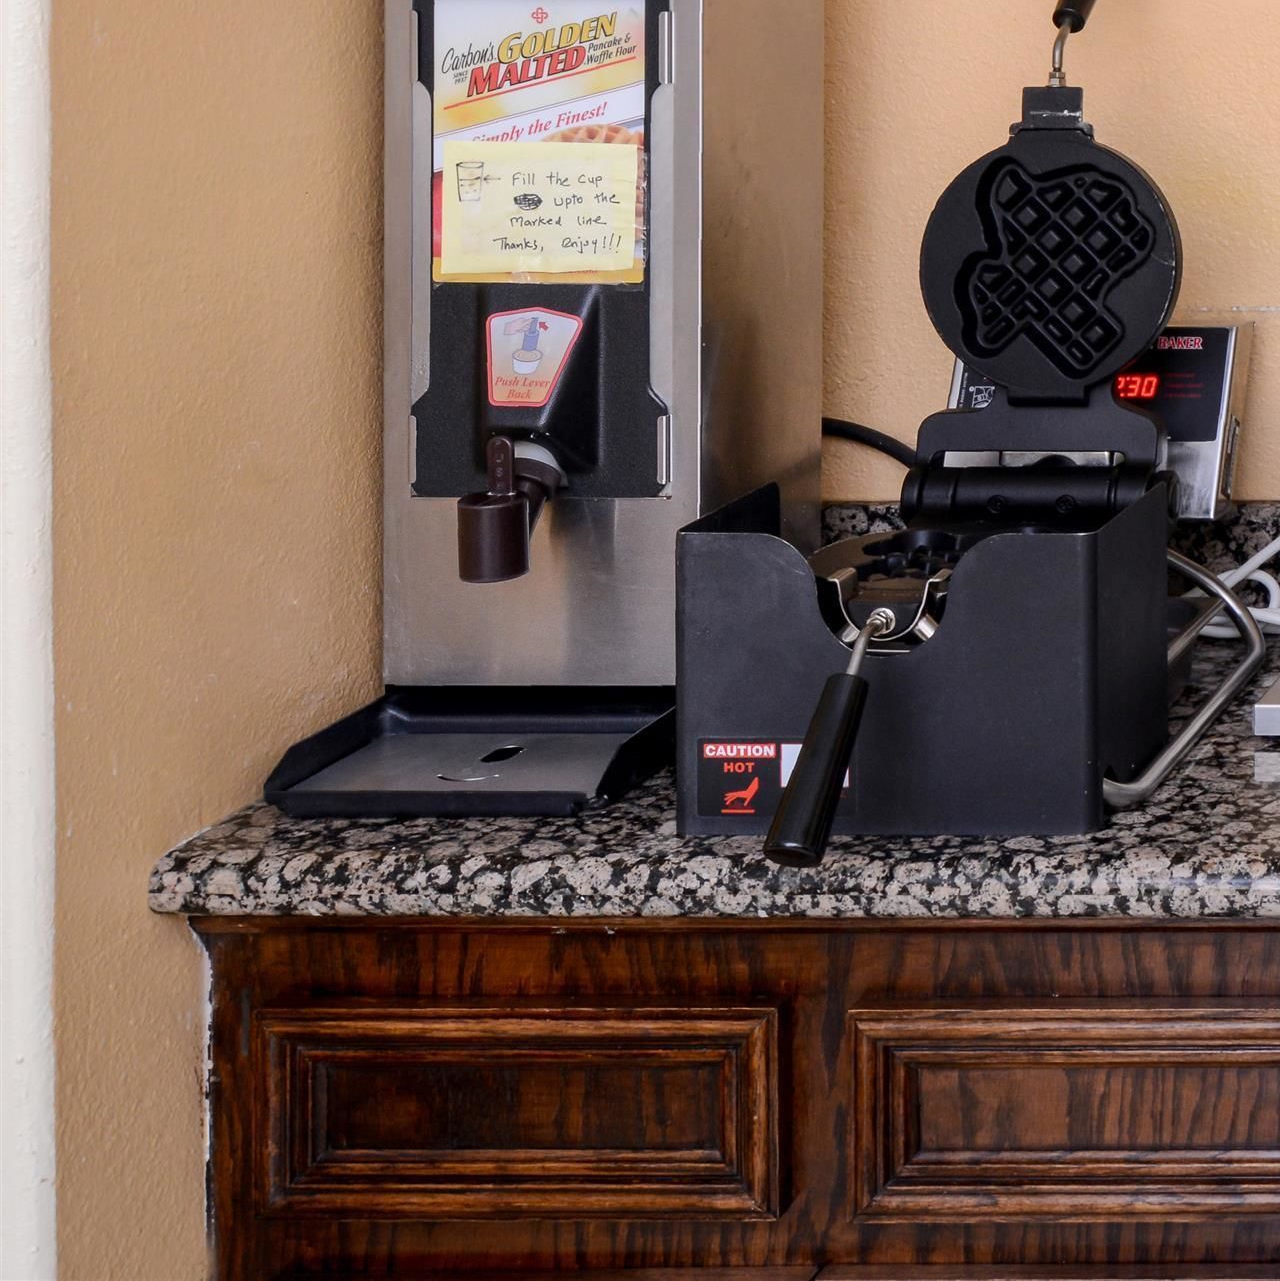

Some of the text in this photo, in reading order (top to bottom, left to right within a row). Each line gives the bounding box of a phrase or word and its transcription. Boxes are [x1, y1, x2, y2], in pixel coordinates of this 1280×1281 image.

[497, 11, 617, 64] GOLDEN
[587, 32, 631, 53] Pancake &
[587, 43, 637, 66] Waffle Flour
[467, 46, 586, 98] MALTED
[528, 118, 551, 135] the
[555, 101, 608, 128] Finest!
[511, 171, 535, 187] Fill
[546, 171, 571, 188] the
[595, 191, 621, 205] the
[577, 214, 608, 227] line
[493, 236, 544, 253] Thanks,
[1157, 336, 1204, 350] BAKER
[495, 376, 551, 388] Push Lever
[507, 389, 532, 400] Back
[705, 744, 775, 757] CAUTION
[723, 762, 755, 773] HOT
